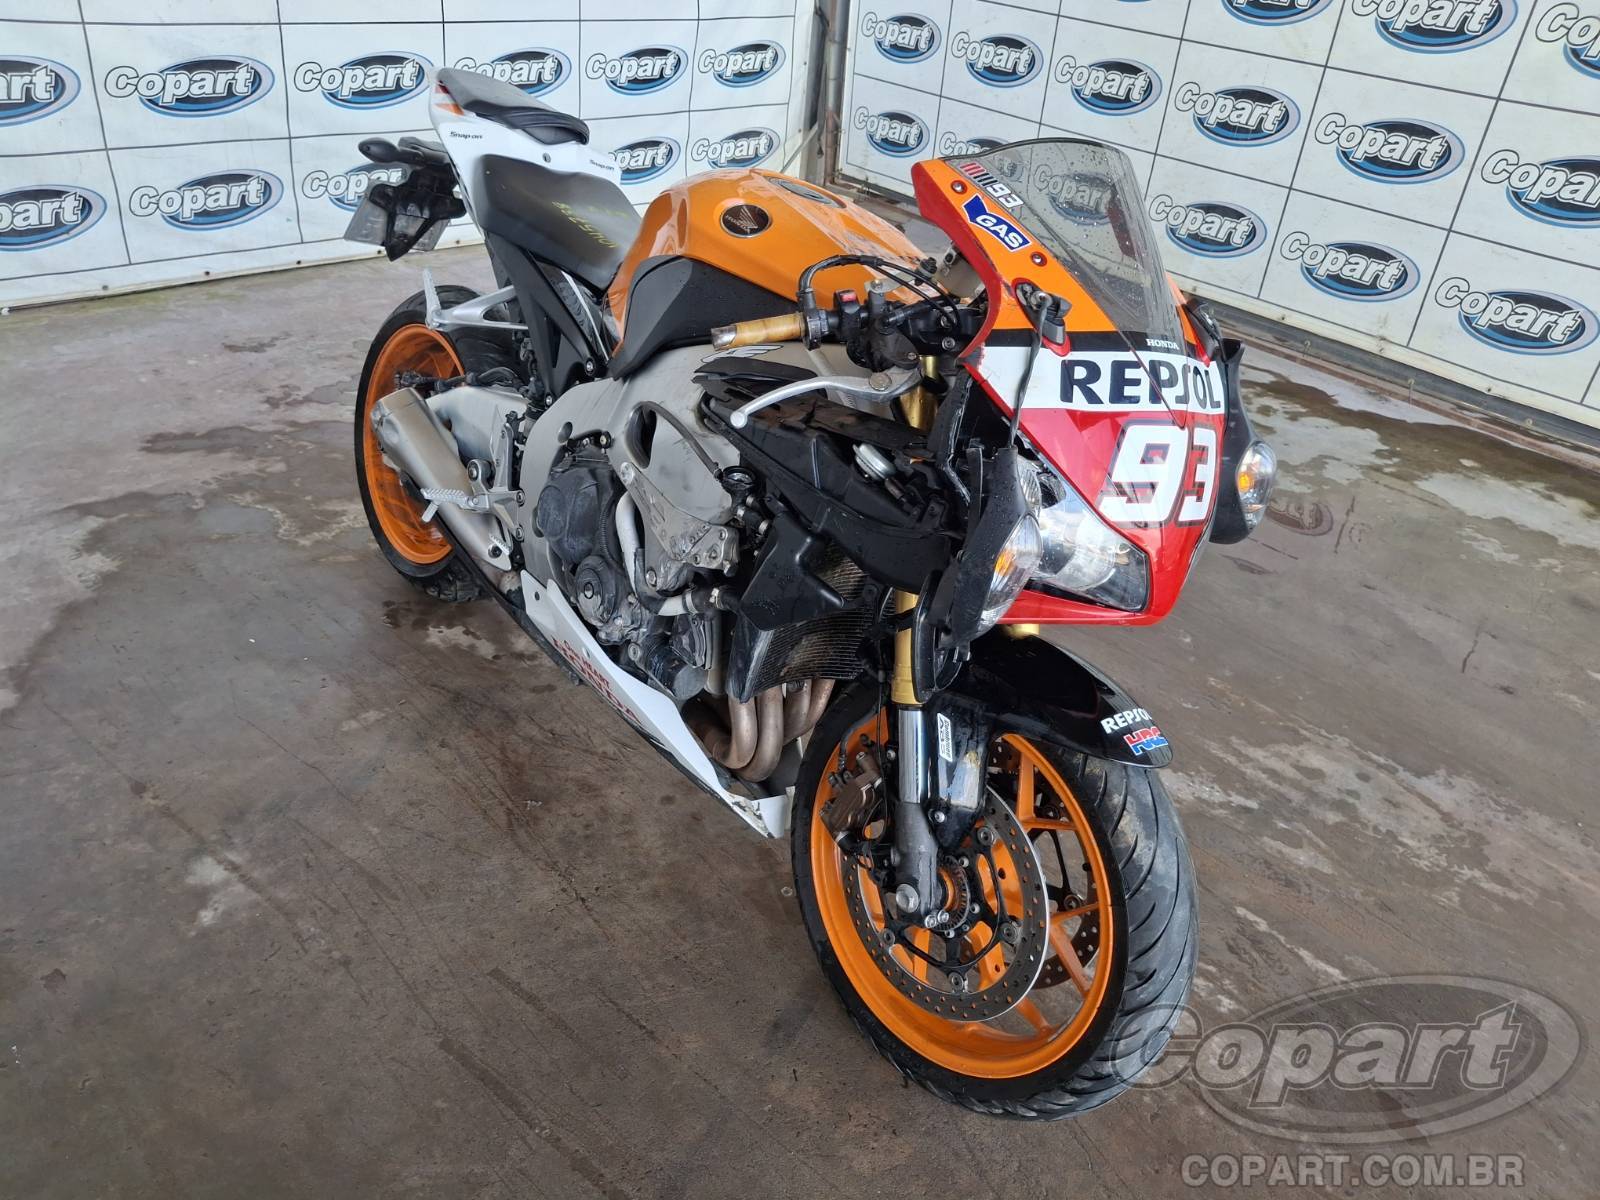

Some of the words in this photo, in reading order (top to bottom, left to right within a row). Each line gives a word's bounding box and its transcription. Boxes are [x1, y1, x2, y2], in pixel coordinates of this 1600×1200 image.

[861, 11, 934, 51] Copart
[585, 50, 678, 83] Copart
[698, 45, 776, 75] Copart
[952, 31, 1034, 75] Copart
[105, 63, 253, 106] Copart
[294, 57, 425, 97] Copart
[1054, 55, 1152, 102] Copart
[854, 105, 921, 148] Copart
[1175, 82, 1287, 133] Copart
[692, 129, 773, 168] Copart
[1315, 112, 1449, 171] Copart
[130, 175, 265, 219] Copart
[986, 183, 1024, 208] 93
[976, 214, 1024, 249] GAS
[1149, 194, 1253, 247] Copart
[1281, 231, 1407, 290] Copart
[1435, 277, 1582, 344] Copart
[1146, 338, 1180, 351] HONDA
[1060, 359, 1221, 409] REPSOL
[1099, 421, 1218, 524] 93
